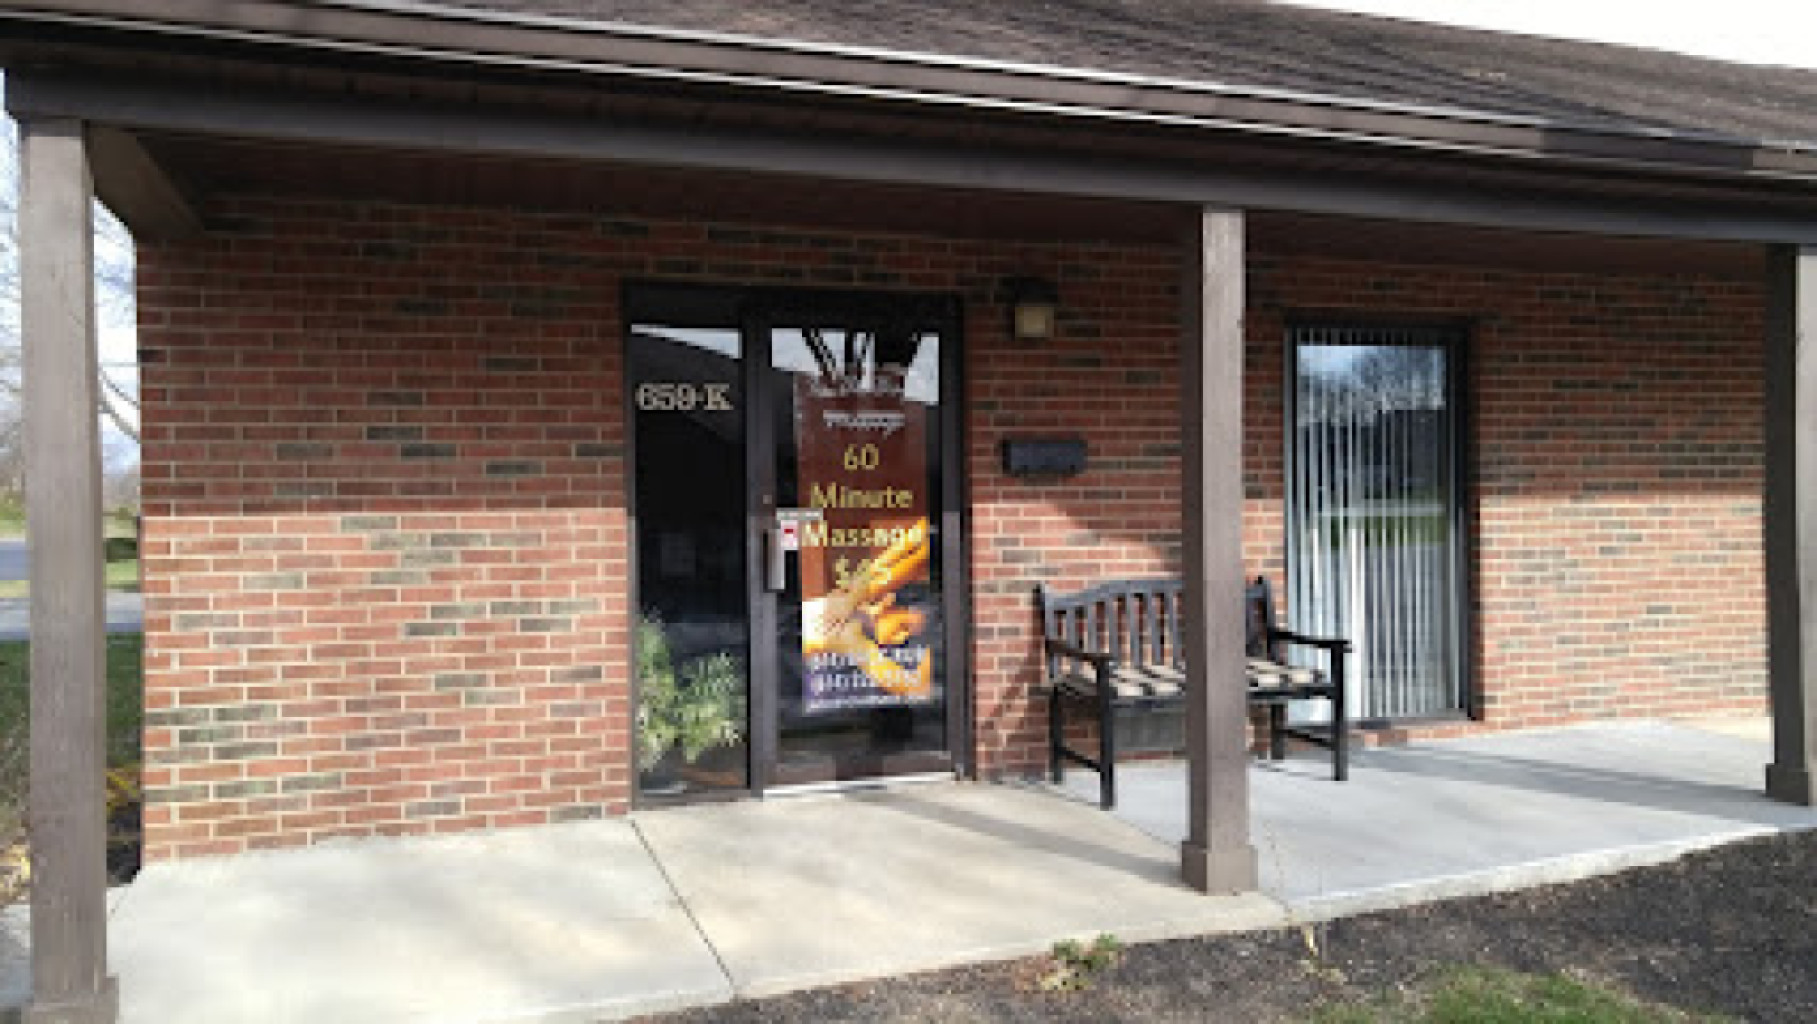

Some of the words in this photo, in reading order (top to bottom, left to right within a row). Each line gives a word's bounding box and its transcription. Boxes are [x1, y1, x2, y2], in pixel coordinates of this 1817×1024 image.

[635, 383, 734, 411] 659-K
[843, 443, 879, 470] 60
[810, 482, 913, 509] Minute
[802, 520, 922, 549] Massage
